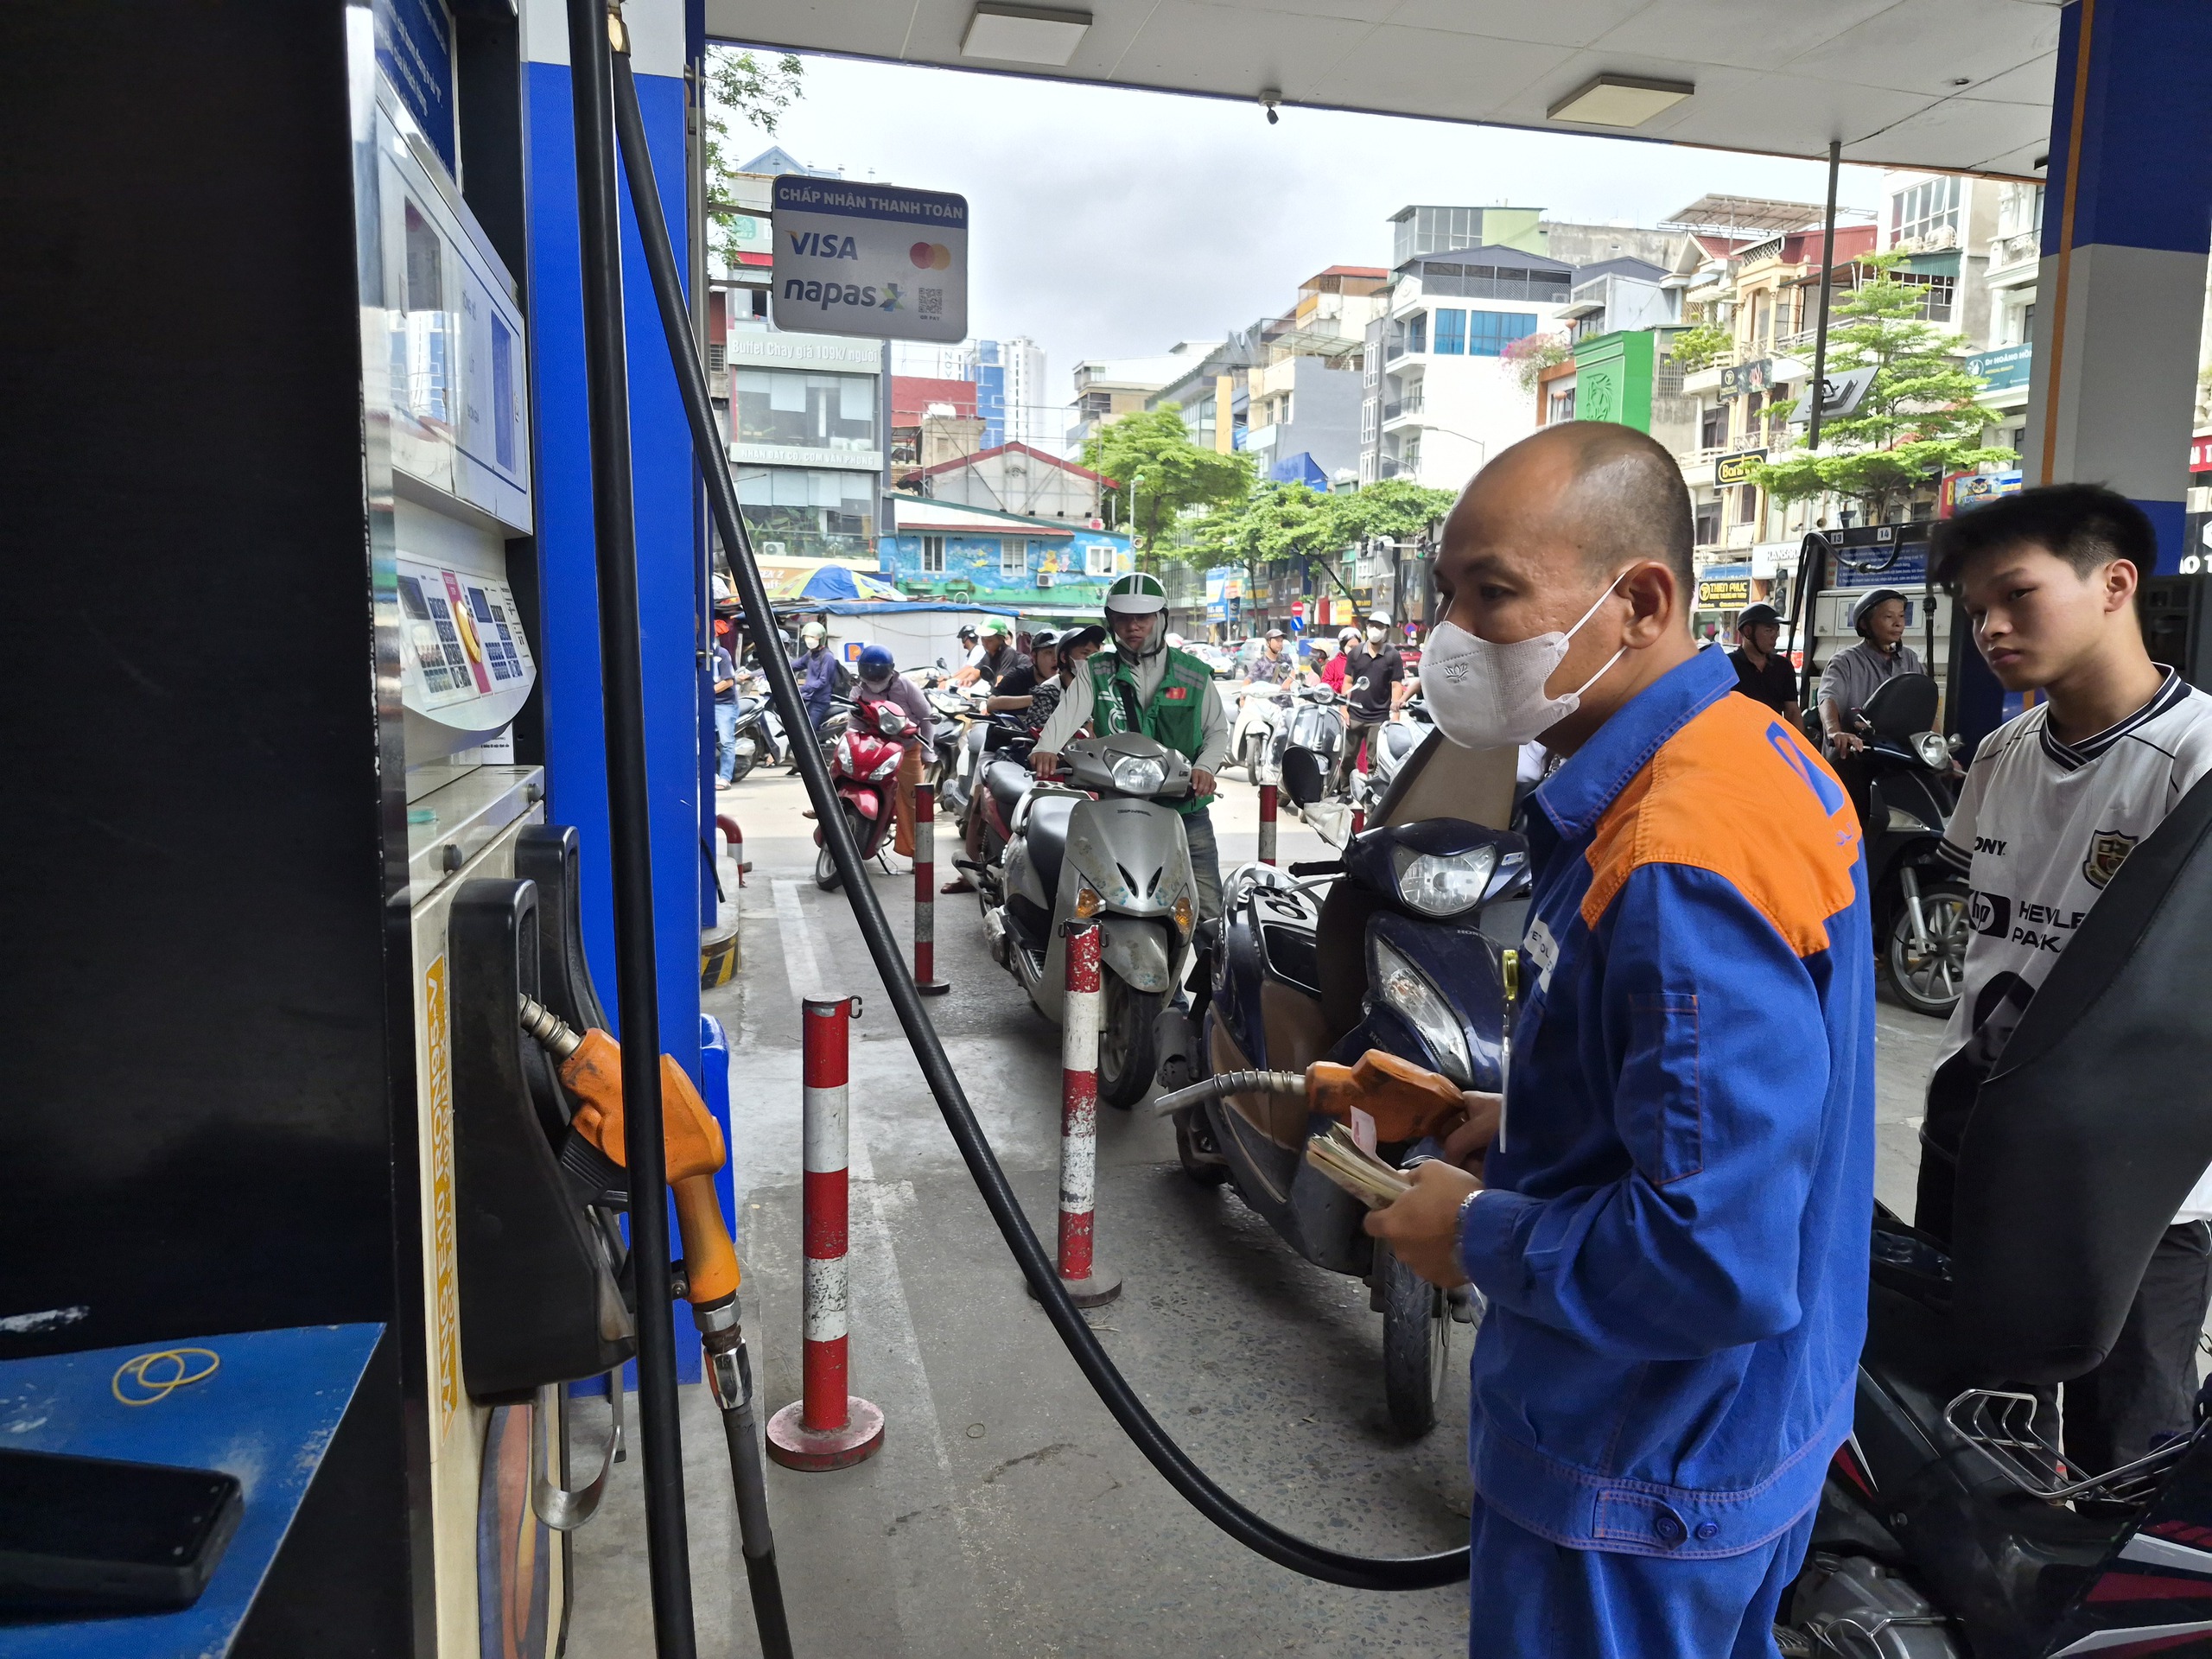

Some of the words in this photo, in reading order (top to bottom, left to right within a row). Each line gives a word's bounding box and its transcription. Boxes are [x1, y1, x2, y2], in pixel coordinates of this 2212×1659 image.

[779, 186, 820, 204] CHẤP
[823, 192, 866, 210] NHẬN
[869, 197, 920, 214] THANH
[923, 203, 963, 219] TOÁN
[785, 230, 858, 261] VISA
[784, 279, 877, 311] napas
[732, 340, 765, 355] Buffet
[766, 341, 794, 359] Chay
[796, 344, 814, 359] giá
[1833, 534, 1842, 543] 13
[1879, 530, 1890, 538] 14
[428, 977, 444, 1181] RON95-V
[436, 1192, 448, 1278] E10
